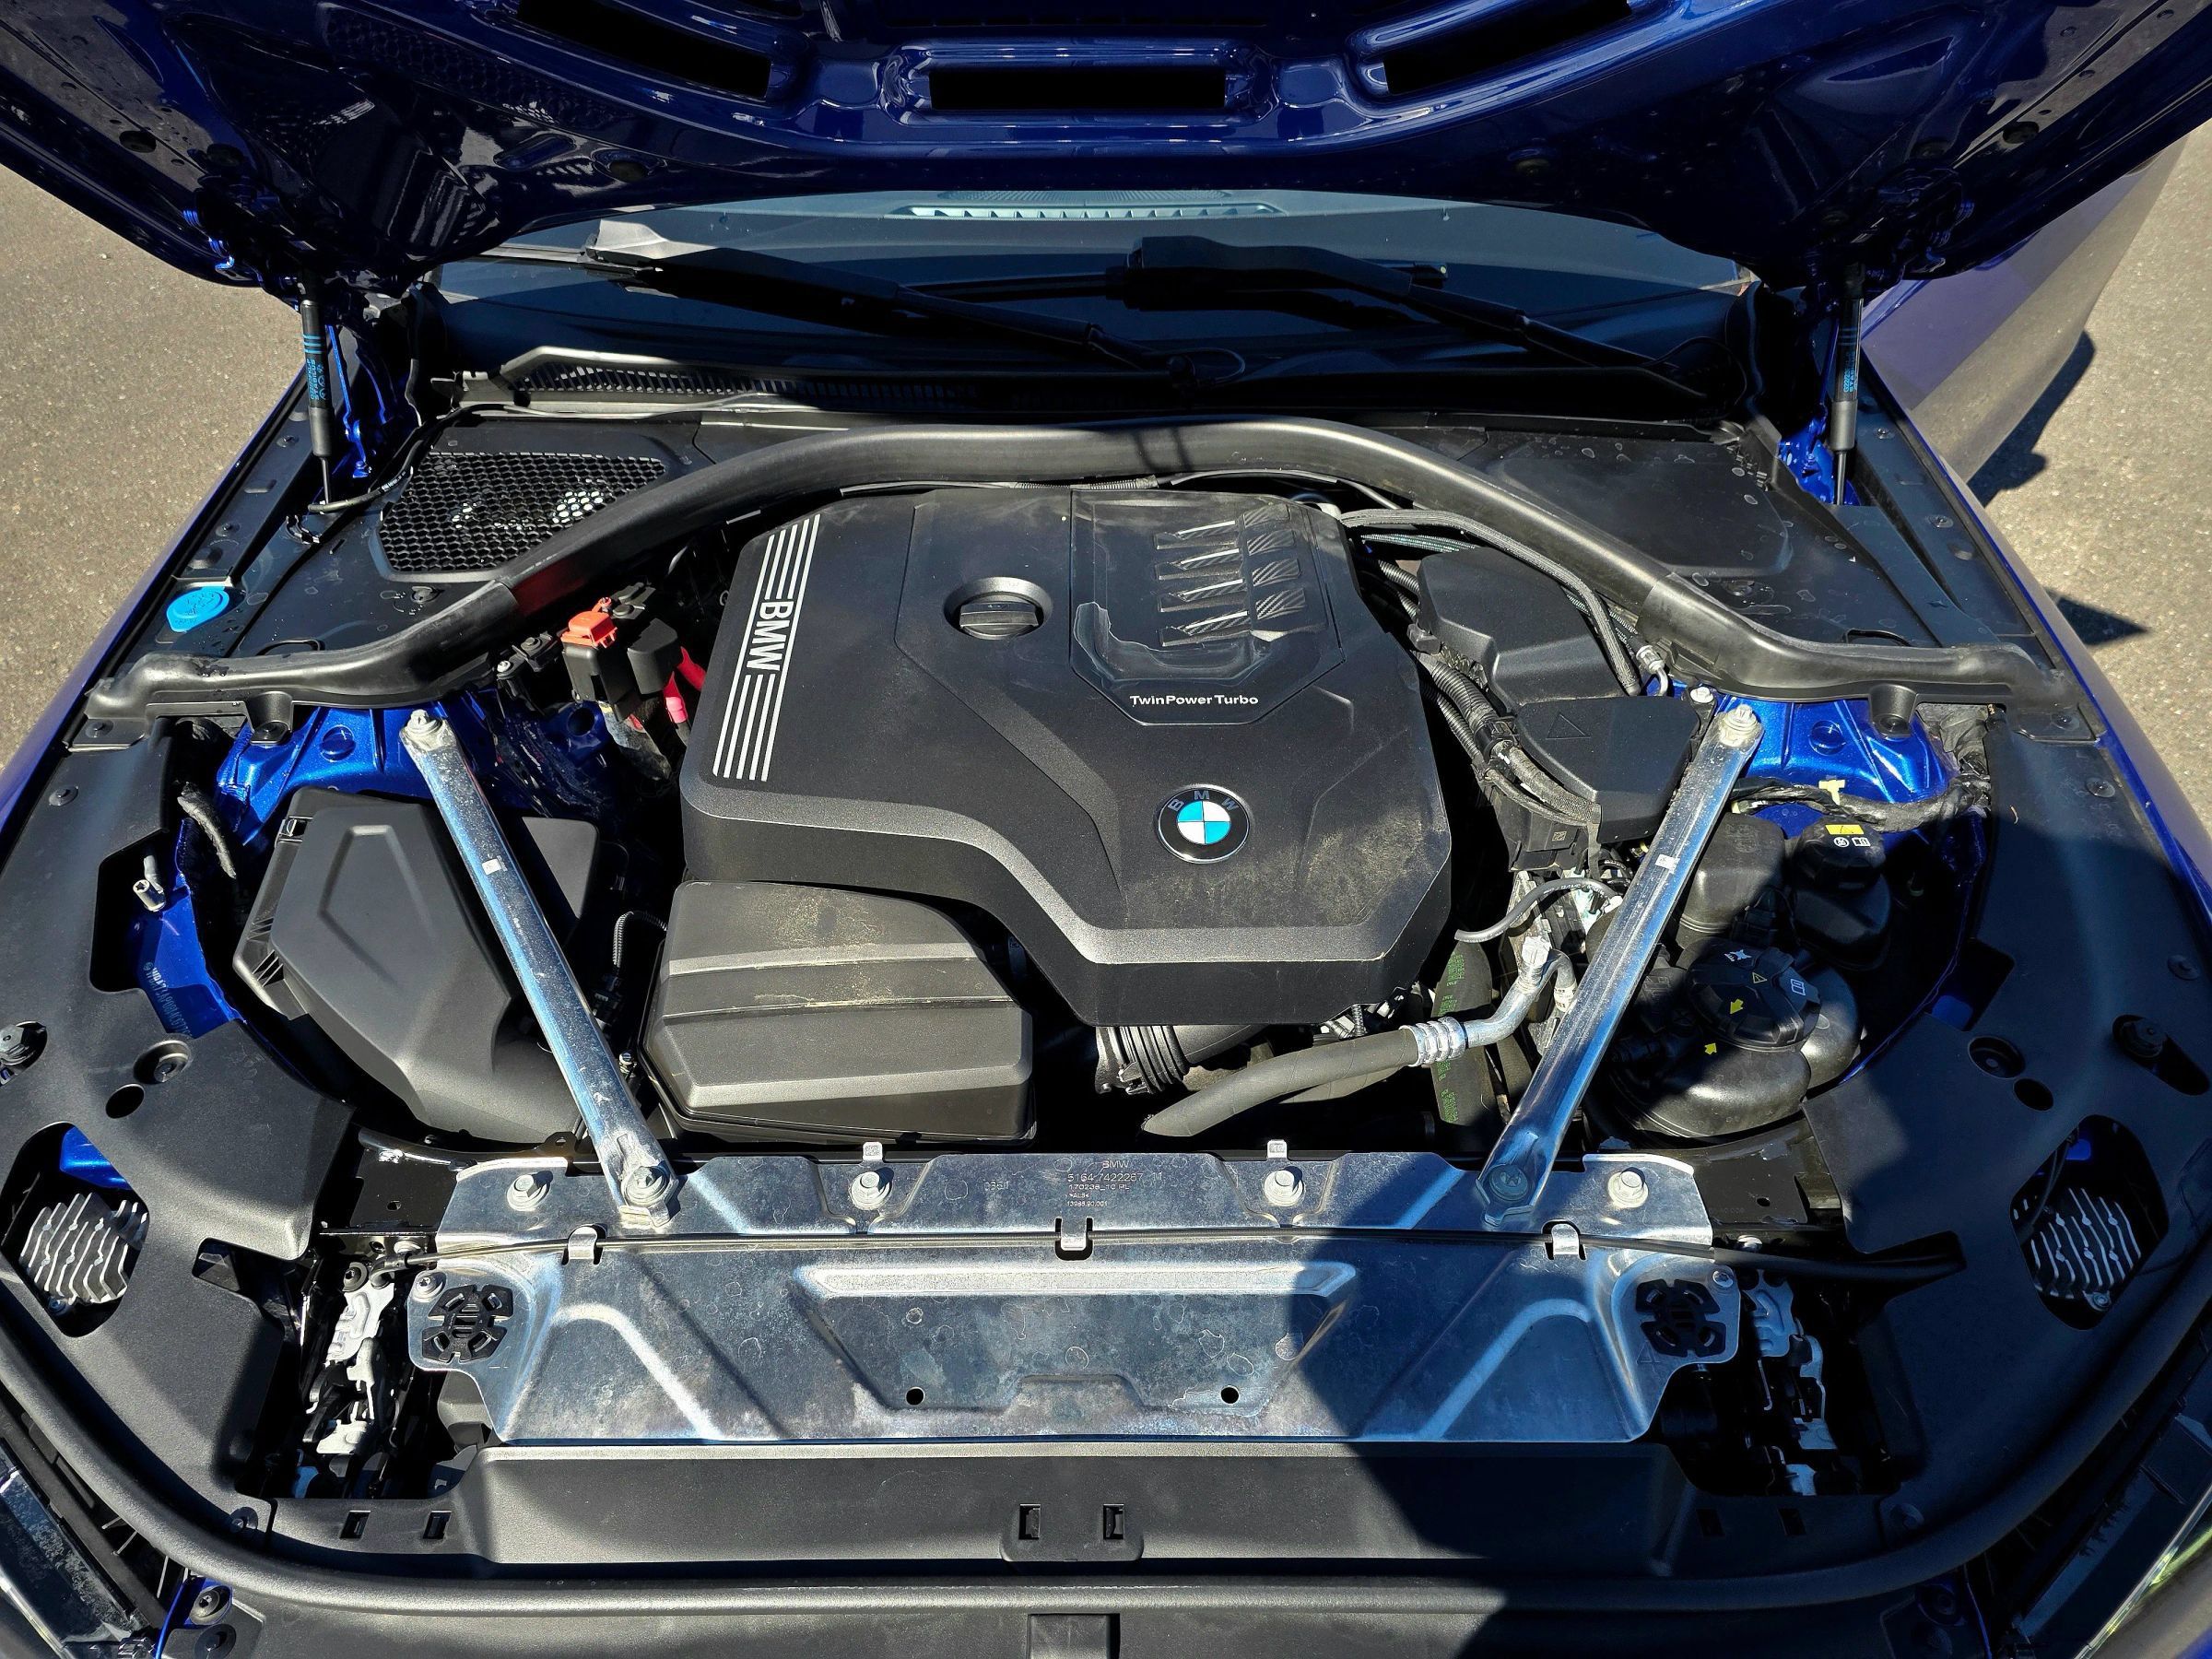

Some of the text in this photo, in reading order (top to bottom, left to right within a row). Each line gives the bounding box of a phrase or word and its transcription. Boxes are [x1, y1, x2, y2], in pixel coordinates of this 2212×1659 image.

[747, 601, 794, 671] BMW
[1214, 695, 1259, 705] Turbo
[1167, 790, 1240, 812] BMW
[1102, 1159, 1130, 1169] BMW
